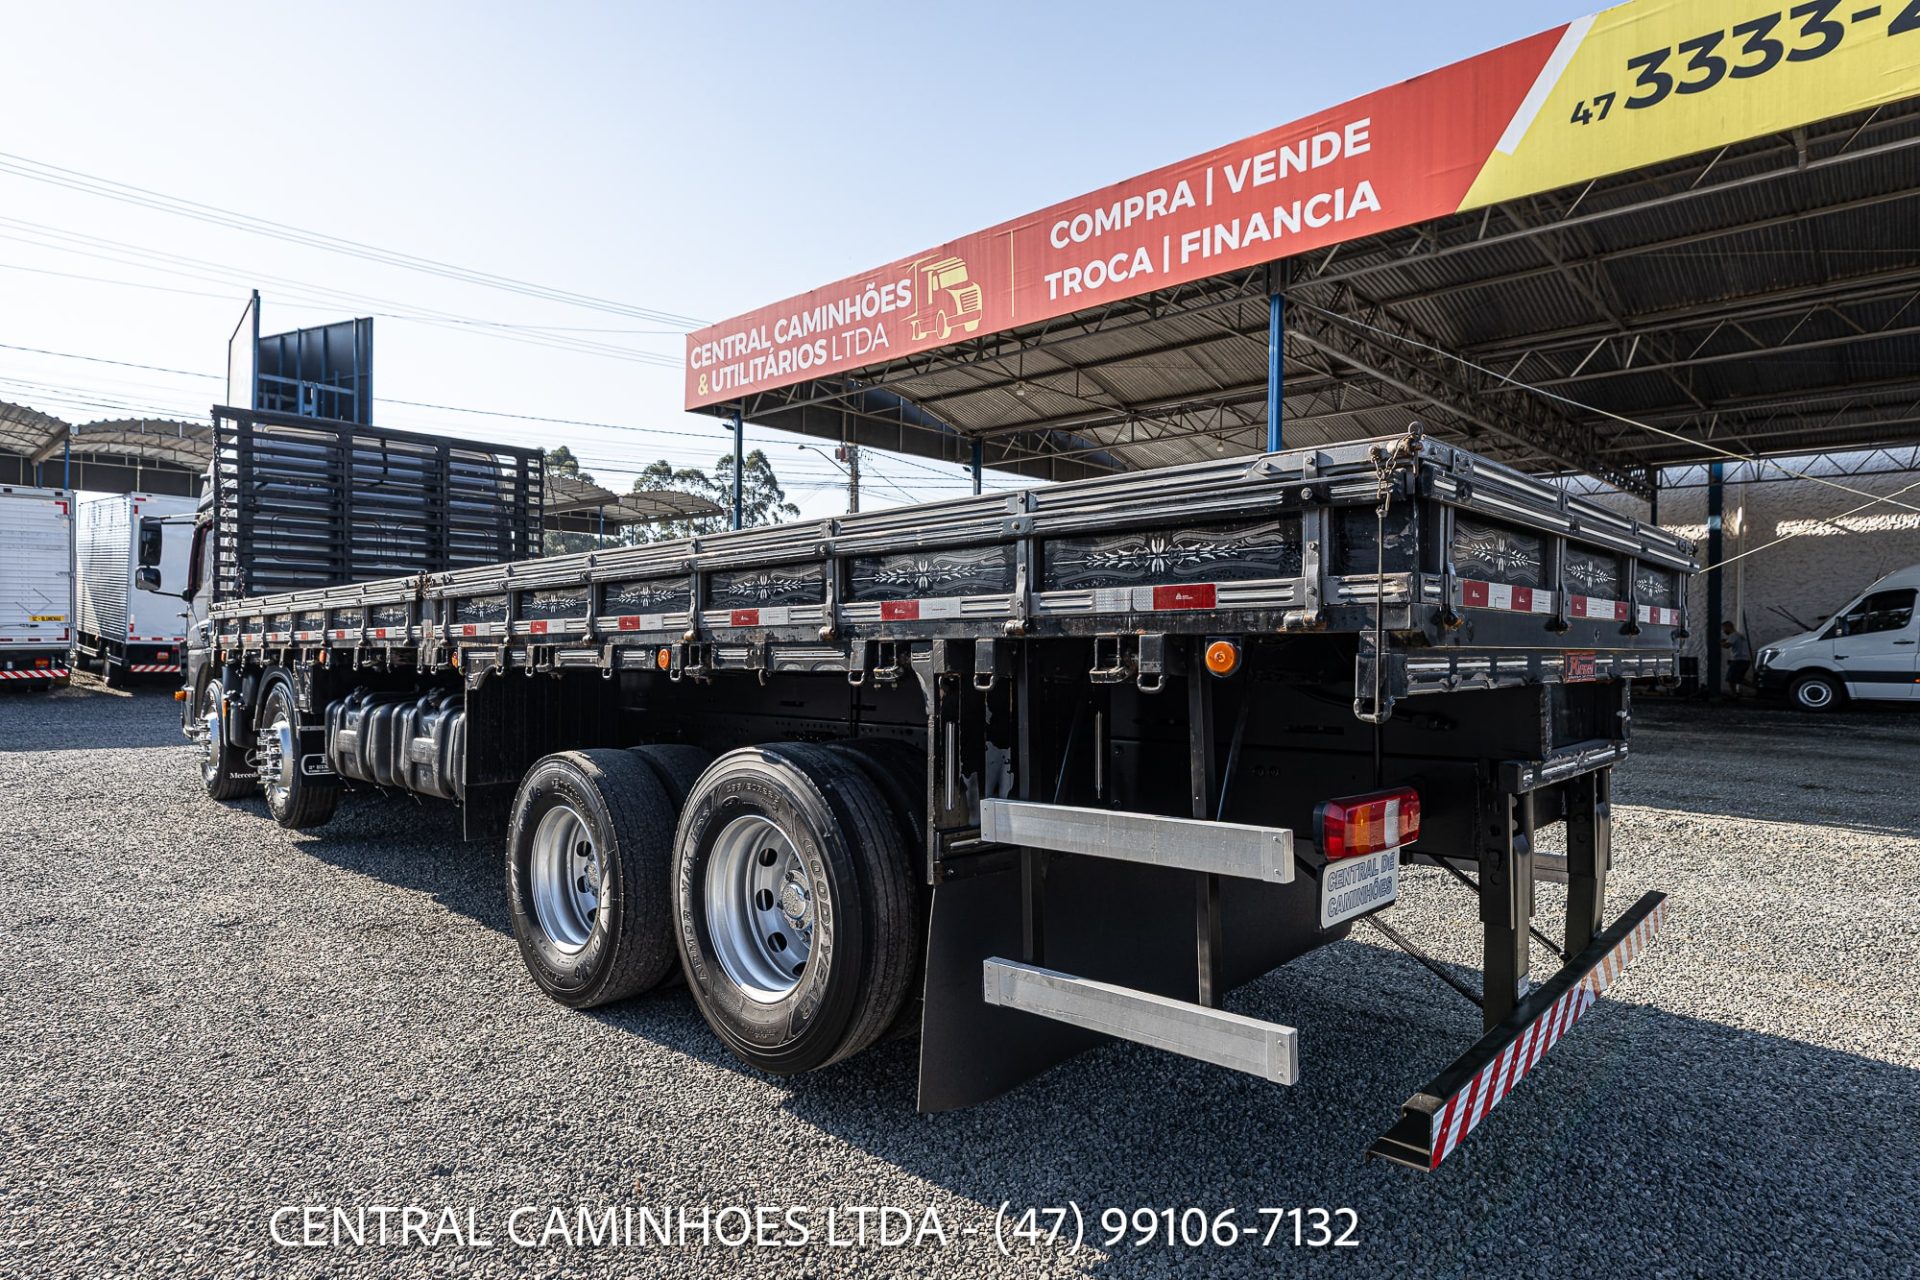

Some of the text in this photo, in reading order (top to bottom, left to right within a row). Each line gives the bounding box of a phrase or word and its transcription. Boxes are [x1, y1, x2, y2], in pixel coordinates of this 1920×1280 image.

[1570, 91, 1616, 126] 47
[1050, 179, 1195, 249] COMPRA
[1224, 117, 1371, 194] VENDE
[1044, 246, 1154, 300] TROCA
[1181, 180, 1381, 264] FINANCIA
[690, 278, 912, 370] CENTRAL CAMINHÕES
[697, 322, 890, 396] & UTILITÁRIOS LTDA
[1327, 852, 1396, 892] CENTRAL DE
[1327, 876, 1393, 917] CAMINHÕES
[803, 839, 834, 1020] GOODYEAR
